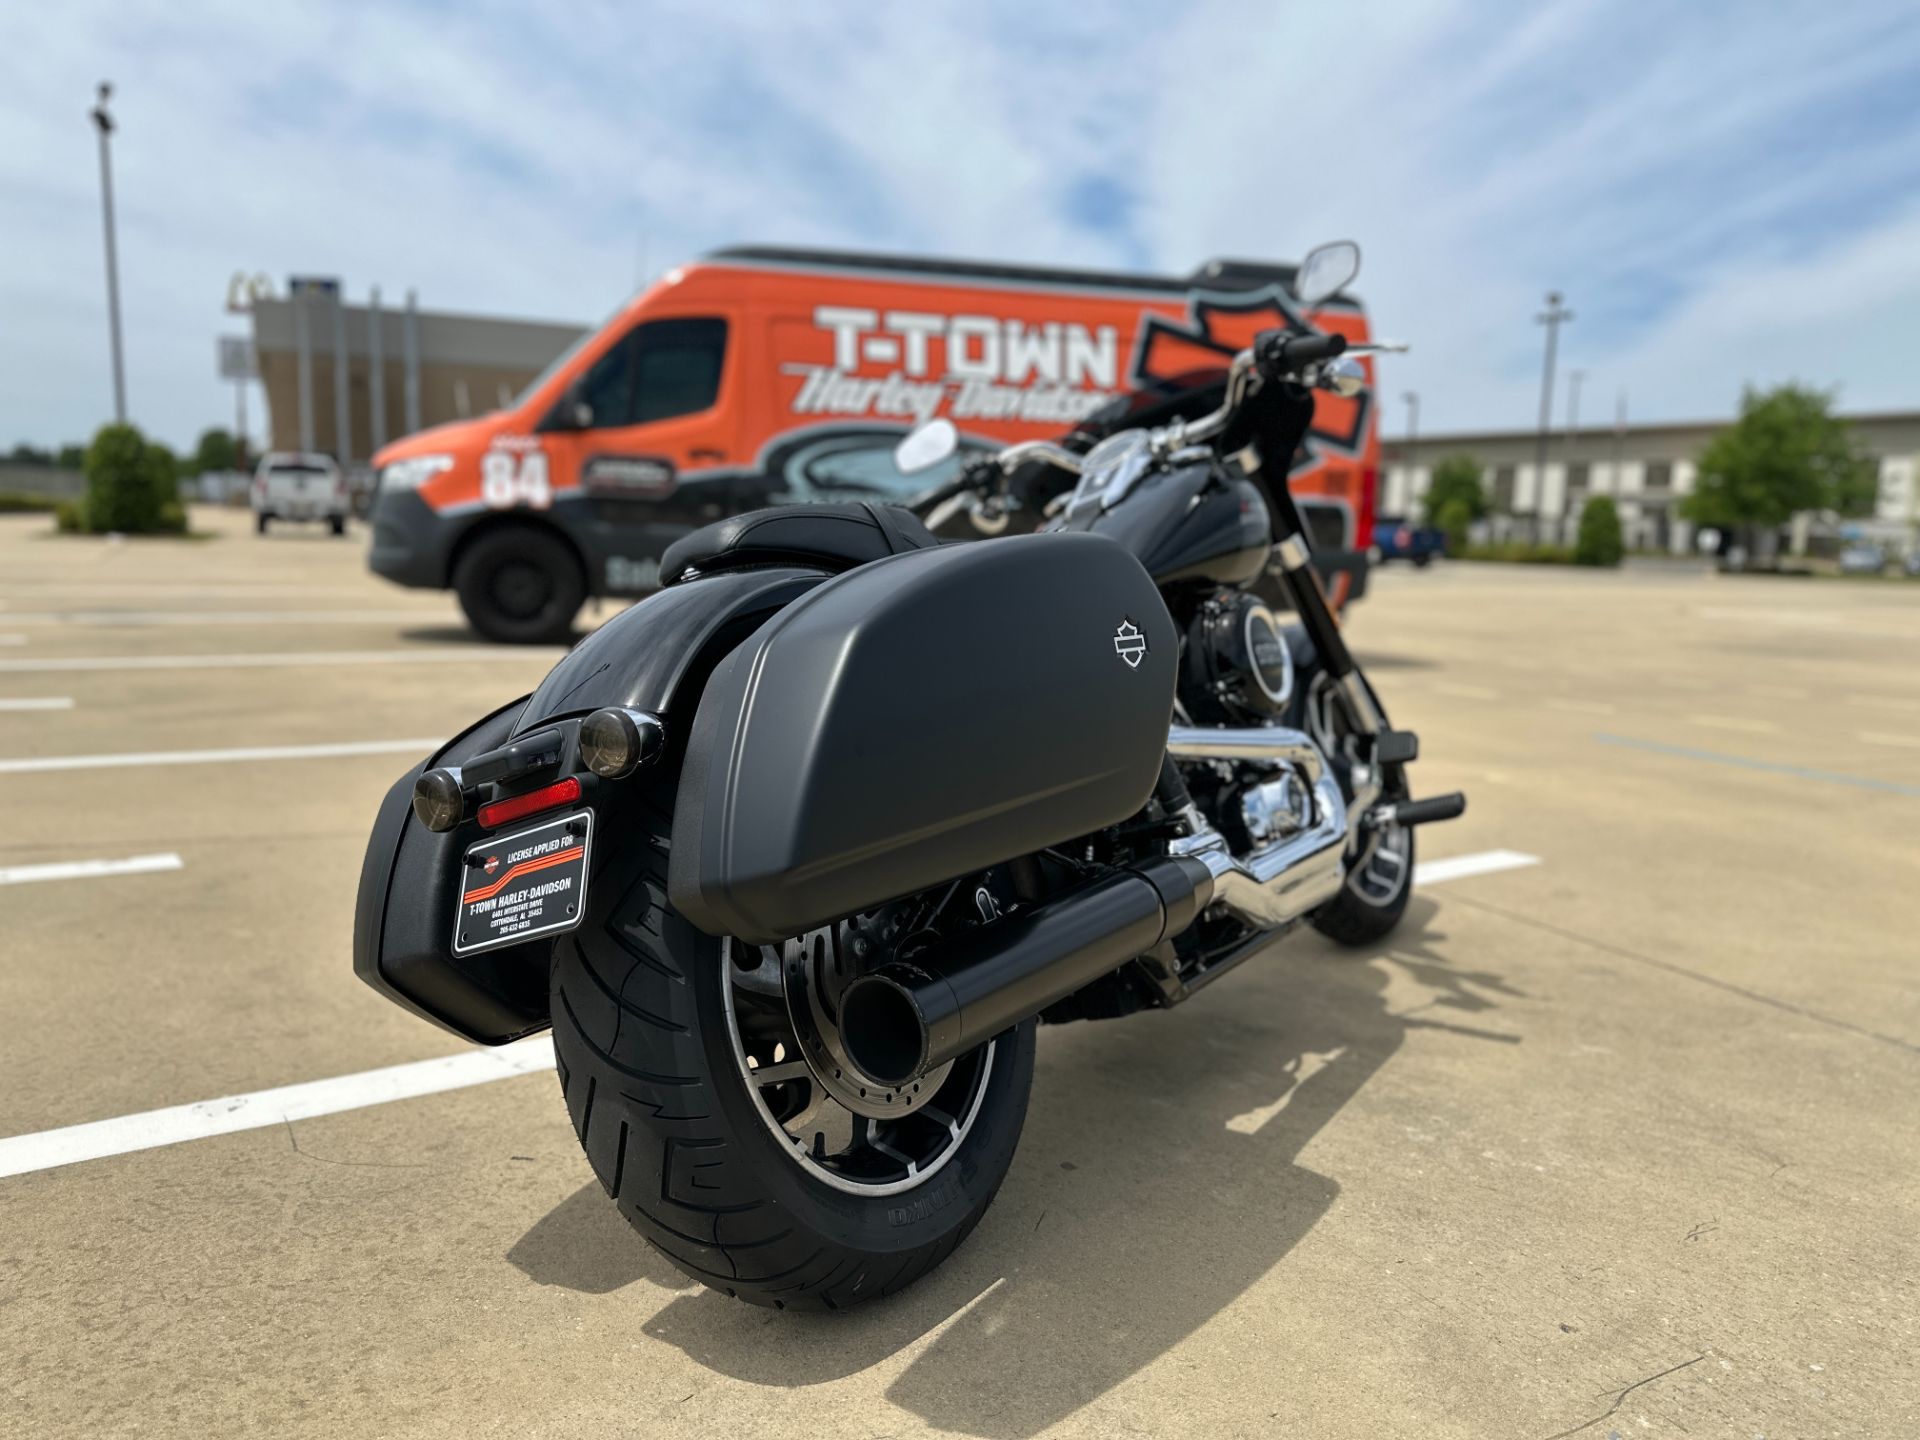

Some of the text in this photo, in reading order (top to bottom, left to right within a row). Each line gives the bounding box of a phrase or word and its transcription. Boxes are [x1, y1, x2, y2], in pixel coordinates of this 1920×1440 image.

[813, 305, 1117, 388] T-TOWN
[482, 452, 552, 510] 84
[507, 835, 574, 864] LICENSE APPLIED FOR
[470, 877, 572, 916] T-TOWN HARLEY-DAVIDSON
